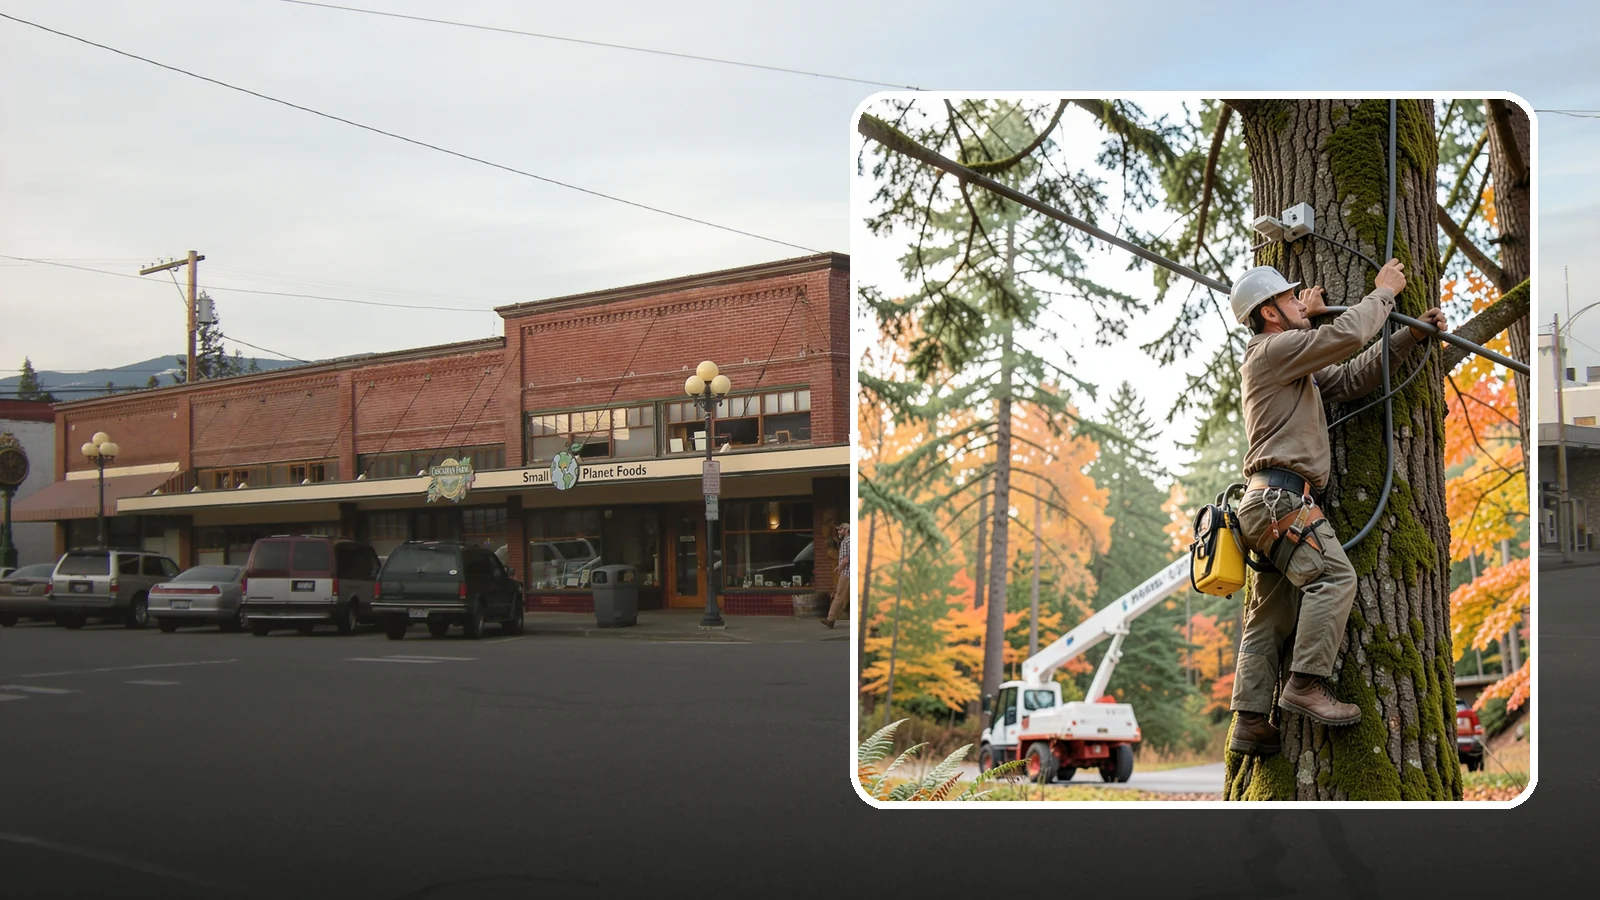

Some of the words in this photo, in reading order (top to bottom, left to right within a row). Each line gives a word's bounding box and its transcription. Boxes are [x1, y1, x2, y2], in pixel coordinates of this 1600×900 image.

[523, 471, 549, 483] Small
[582, 467, 614, 479] Planet
[616, 464, 647, 477] Foods
